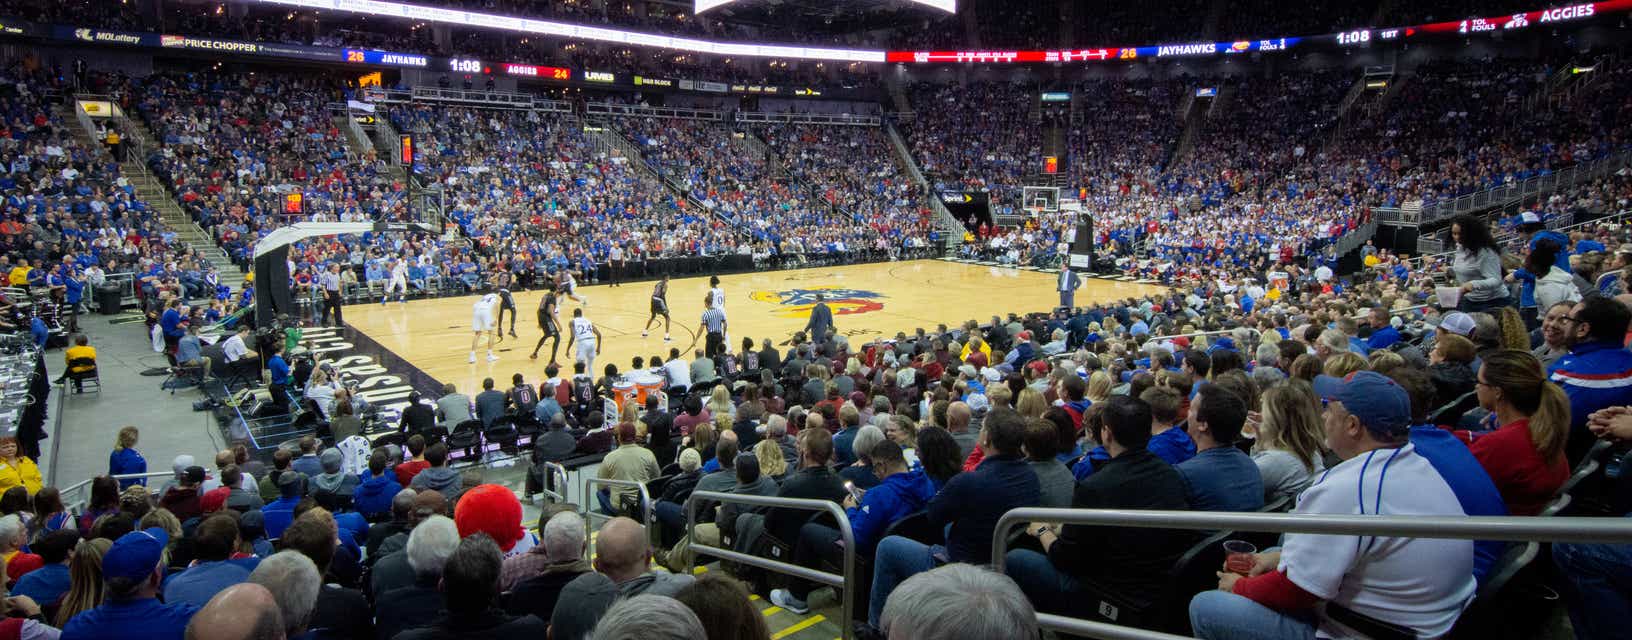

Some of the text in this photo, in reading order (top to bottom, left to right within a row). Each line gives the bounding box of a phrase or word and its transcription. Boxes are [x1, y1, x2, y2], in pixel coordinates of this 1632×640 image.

[1540, 3, 1595, 22] AGGIES
[1472, 23, 1496, 32] FOULS
[96, 32, 140, 44] MOLottery
[1336, 29, 1370, 44] 1:08
[1381, 30, 1398, 39] 1ST
[185, 39, 212, 48] PRICE
[213, 41, 256, 52] CHOPPER
[1157, 43, 1216, 57] JAYHAWKS
[347, 51, 365, 62] 26
[1120, 48, 1137, 59] 26
[381, 54, 427, 66] JAYHAWKS
[450, 58, 481, 73] 1:08
[508, 65, 538, 75] AGGIES
[554, 69, 568, 79] 24
[579, 325, 594, 335] 24
[520, 389, 531, 403] 0
[583, 385, 592, 401] 4
